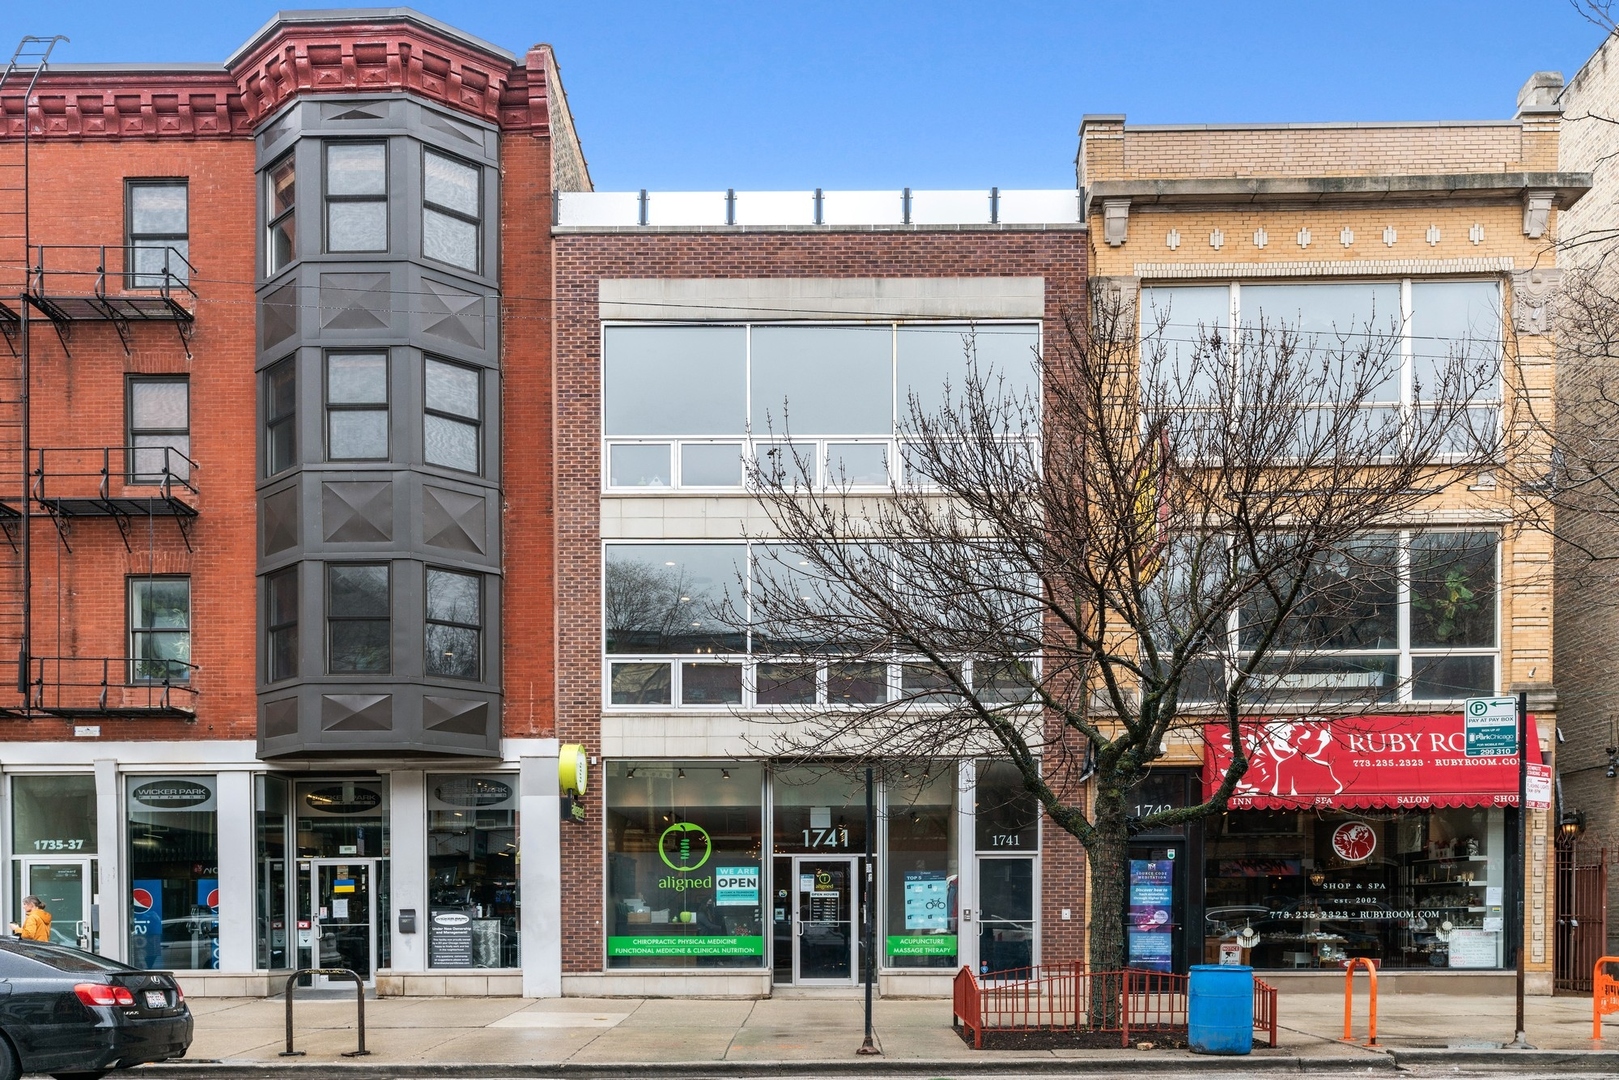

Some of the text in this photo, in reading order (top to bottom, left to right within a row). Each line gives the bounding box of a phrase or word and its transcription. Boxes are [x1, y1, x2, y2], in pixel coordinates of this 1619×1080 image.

[1475, 732, 1514, 741] ParkChicago
[1349, 732, 1466, 753] RUBY RO
[1397, 796, 1430, 804] SALON
[802, 829, 849, 848] 1741
[992, 834, 1020, 846] 1741
[34, 839, 84, 850] 1735-37
[658, 875, 712, 892] aligned
[718, 878, 757, 888] OPEN
[1269, 910, 1440, 919] 773.235.2323 RUBYROOM.COM
